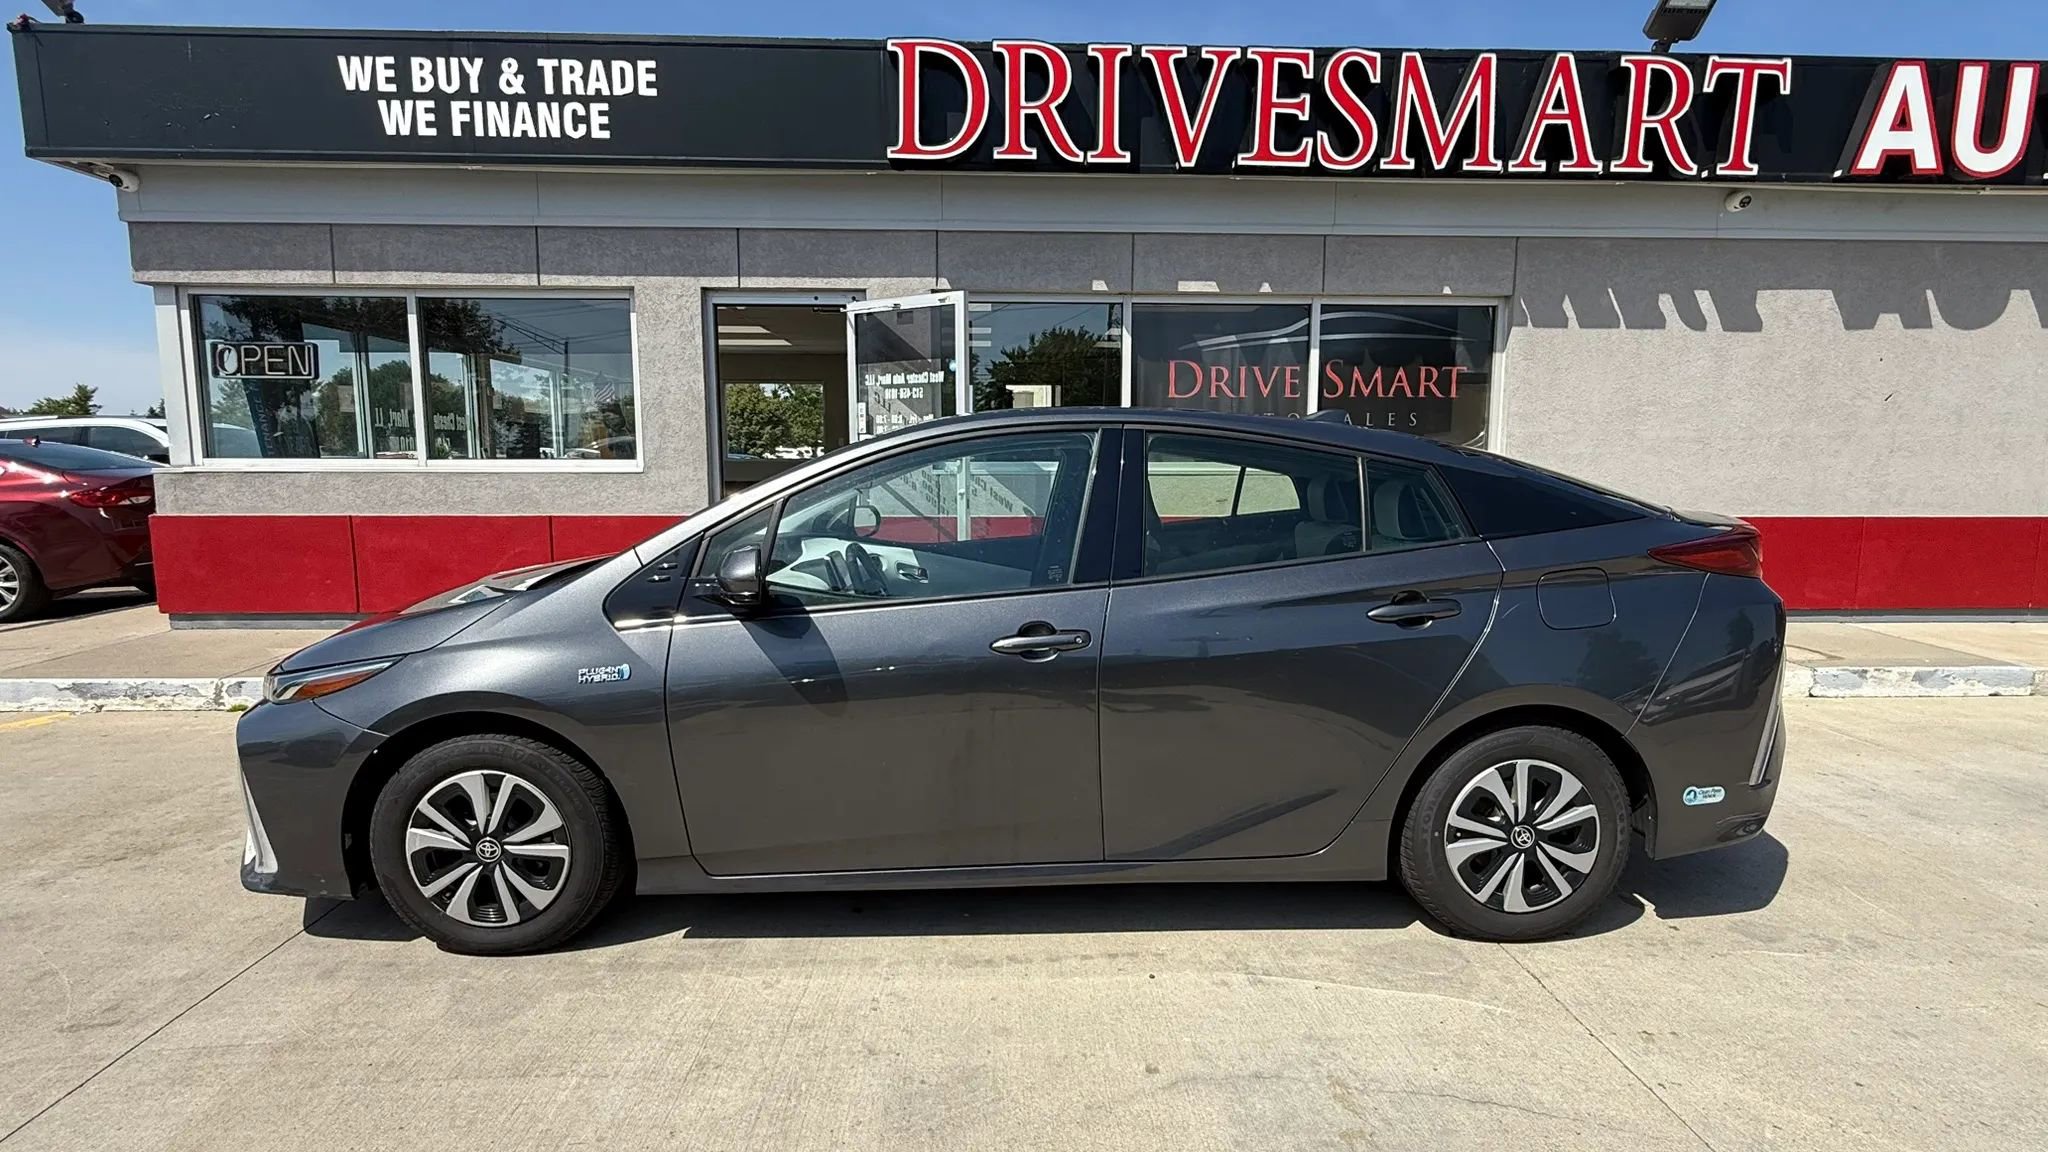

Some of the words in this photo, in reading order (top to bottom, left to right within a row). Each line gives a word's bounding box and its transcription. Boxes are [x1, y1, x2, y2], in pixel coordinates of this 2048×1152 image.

[337, 55, 397, 92] WE
[410, 56, 484, 93] BUY
[498, 57, 526, 95] &
[537, 58, 658, 96] TRADE
[377, 99, 437, 136] WE
[450, 100, 611, 139] FINANCE
[887, 38, 1792, 176] DRIVESMART
[1850, 58, 2041, 178] AU
[216, 344, 310, 376] OPEN
[1168, 359, 1301, 399] DRIVE
[1323, 359, 1469, 399] SMART
[1344, 412, 1417, 426] ALES
[578, 674, 620, 683] HYBRID
